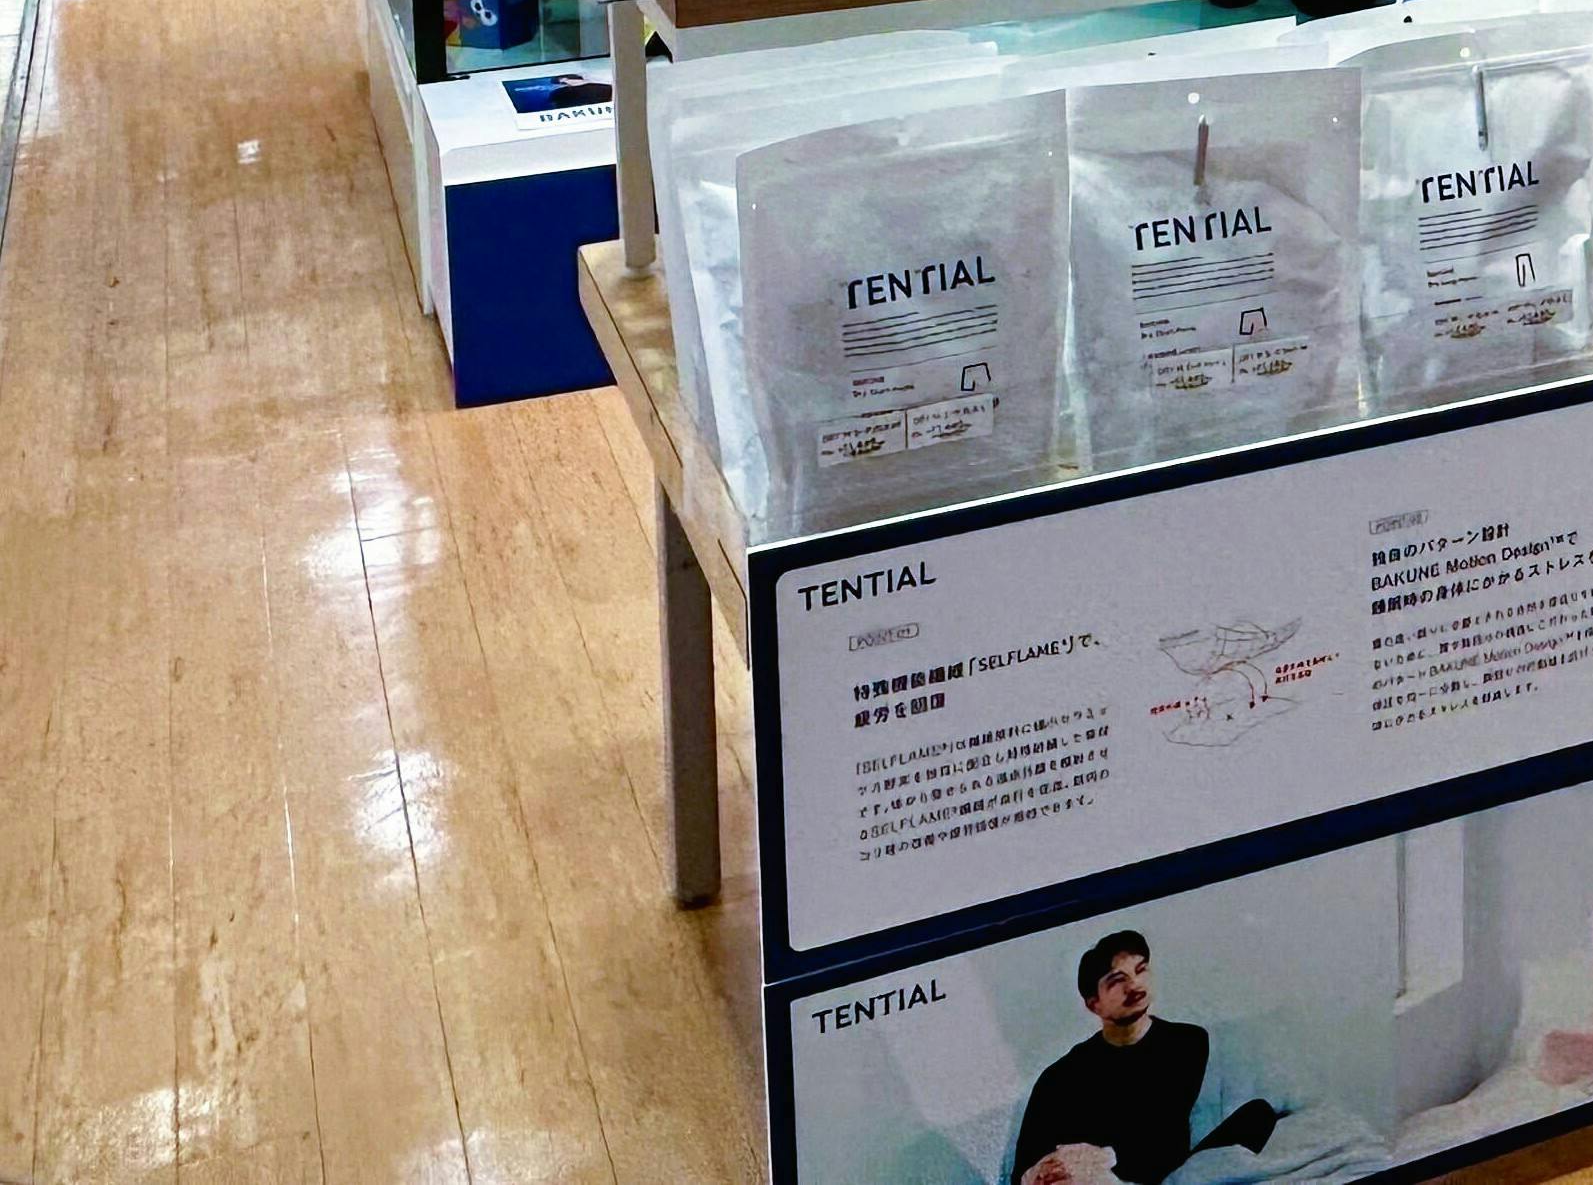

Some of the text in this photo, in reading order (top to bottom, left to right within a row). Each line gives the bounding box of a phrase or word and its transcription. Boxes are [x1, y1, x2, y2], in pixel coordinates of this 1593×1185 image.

[1418, 160, 1540, 204] TENTIAL
[1133, 205, 1273, 251] TENTIAL
[846, 255, 997, 310] TENTIAL
[797, 560, 938, 613] TENTIAL
[812, 977, 947, 1035] TENTIAL
